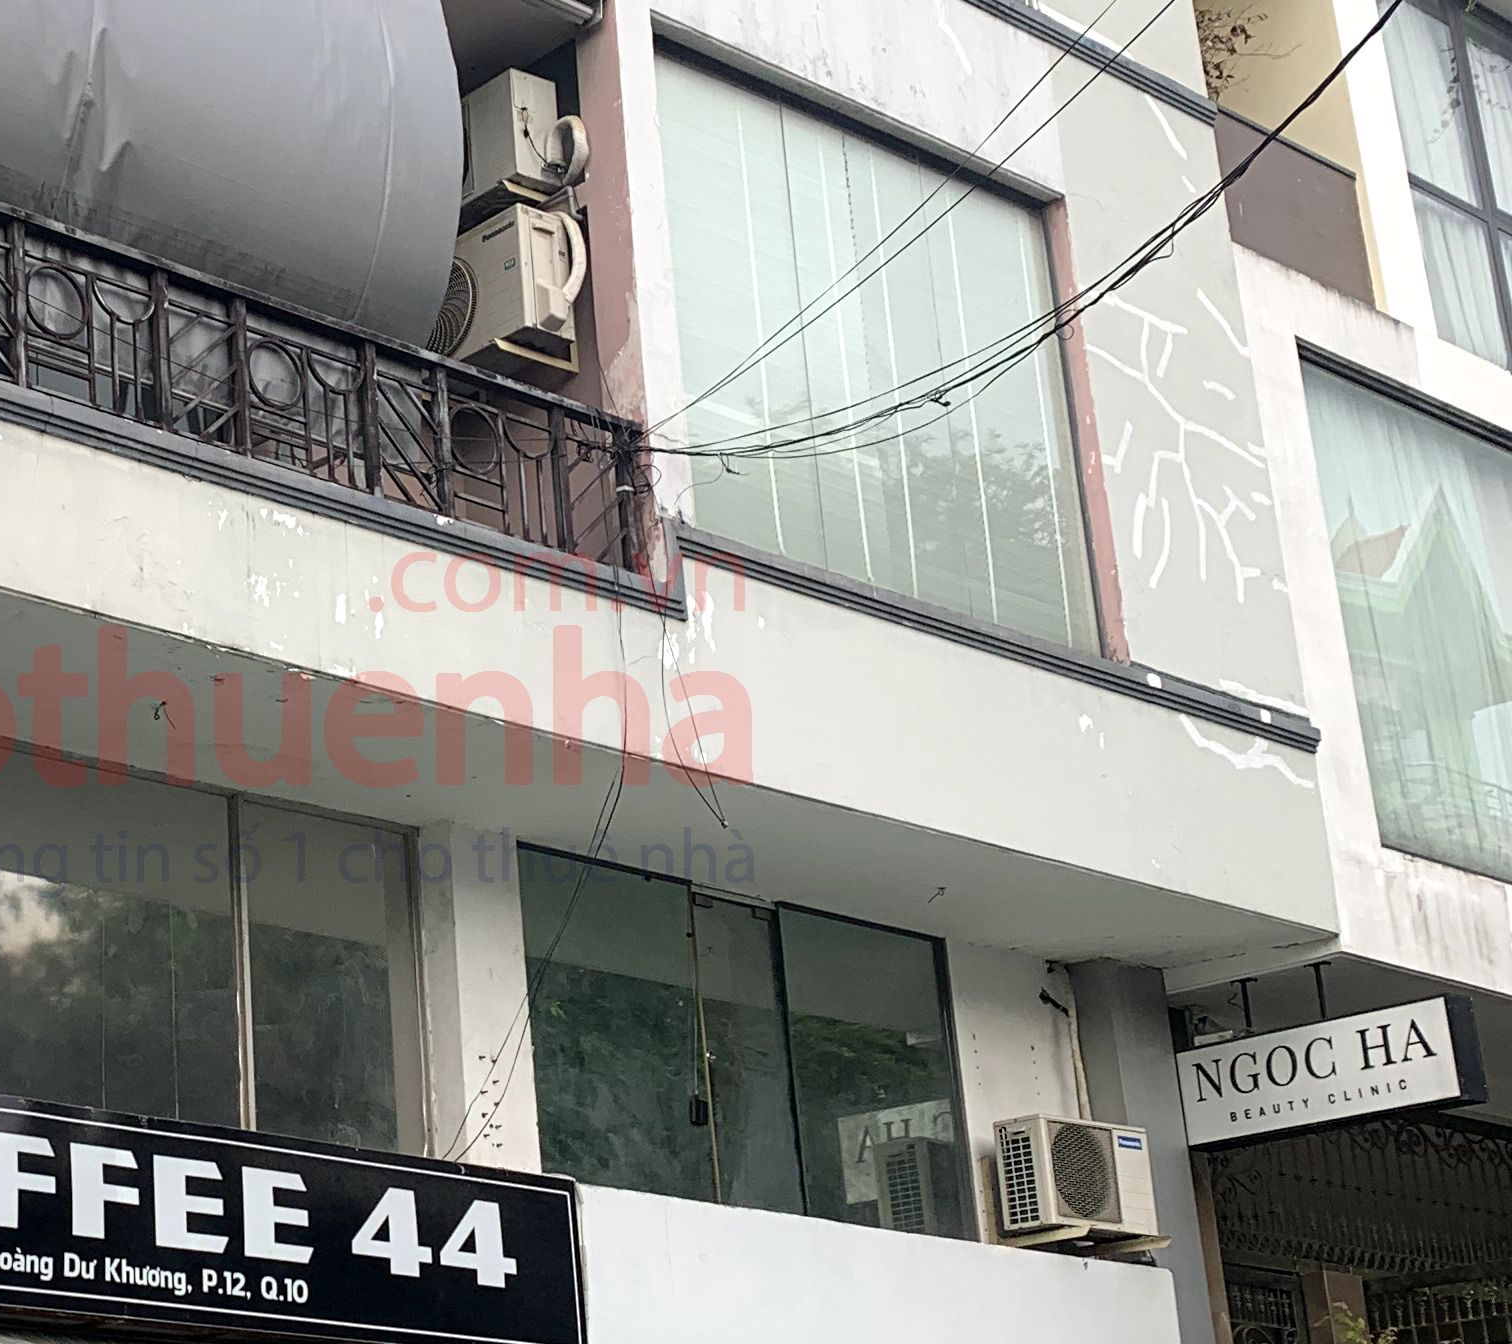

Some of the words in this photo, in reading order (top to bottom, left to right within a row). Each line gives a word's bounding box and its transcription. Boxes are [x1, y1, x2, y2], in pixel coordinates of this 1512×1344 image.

[1192, 1036, 1337, 1103] NGOC
[1355, 1018, 1437, 1070] HA
[1230, 1096, 1311, 1122] BEAUTY
[1328, 1078, 1408, 1105] CLINIC
[351, 1186, 518, 1289] 44
[63, 1252, 97, 1280] Dư
[105, 1257, 193, 1296] Khương,
[202, 1269, 252, 1300] P.12,
[261, 1276, 309, 1304] Q.10
